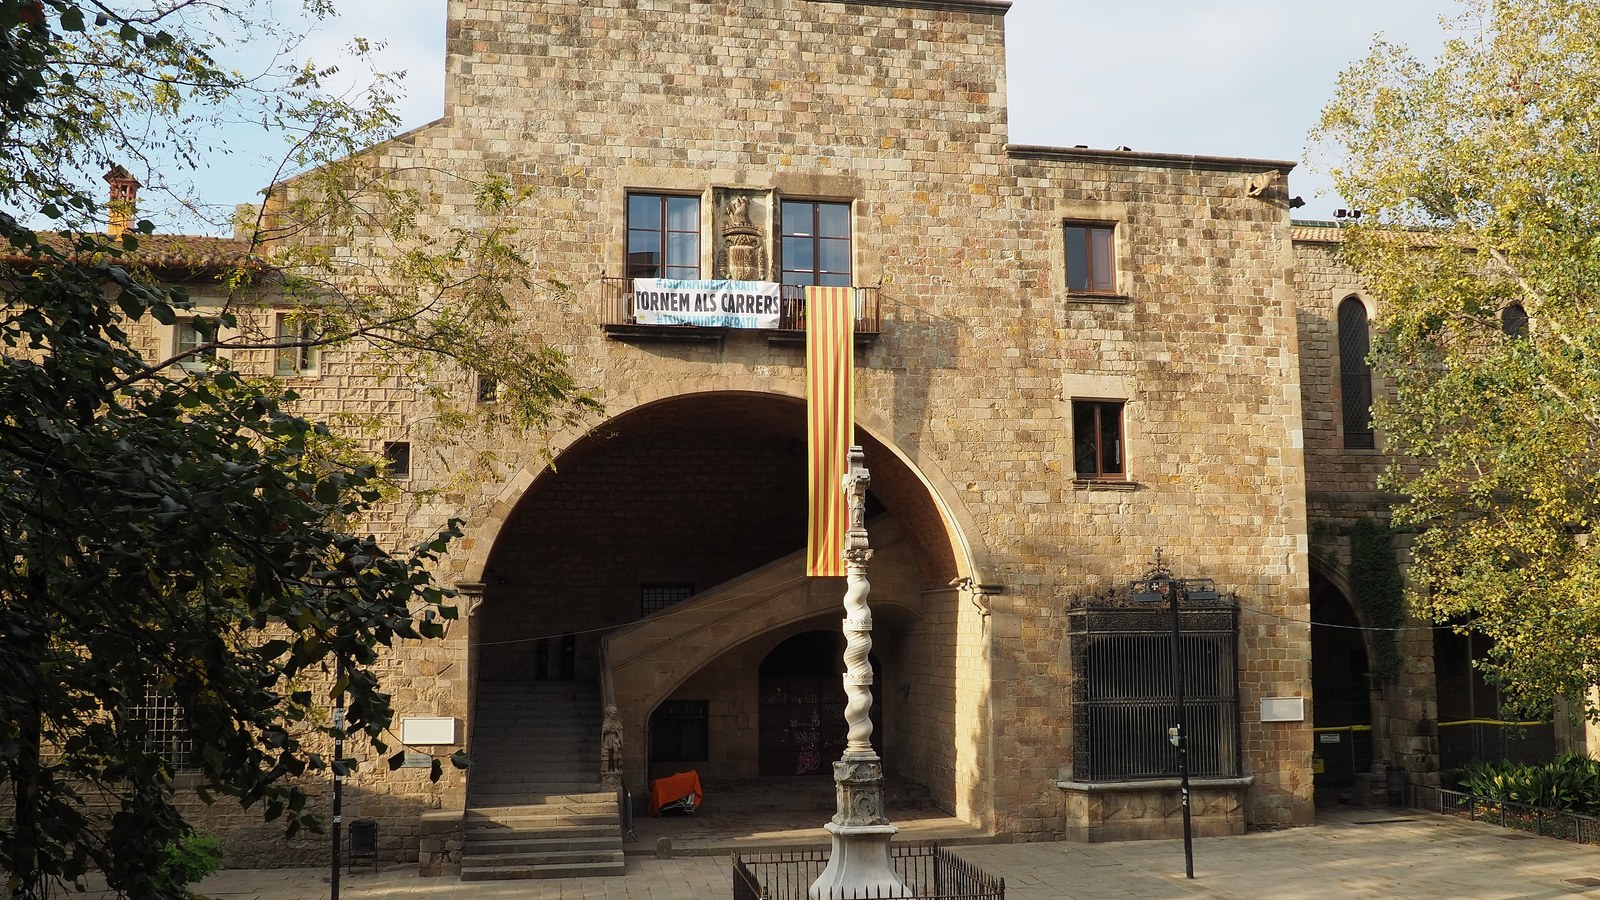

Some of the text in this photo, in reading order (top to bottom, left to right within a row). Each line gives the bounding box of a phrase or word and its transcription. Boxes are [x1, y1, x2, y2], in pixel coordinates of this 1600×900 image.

[635, 290, 779, 315] TORNEM ALS CARRERS
